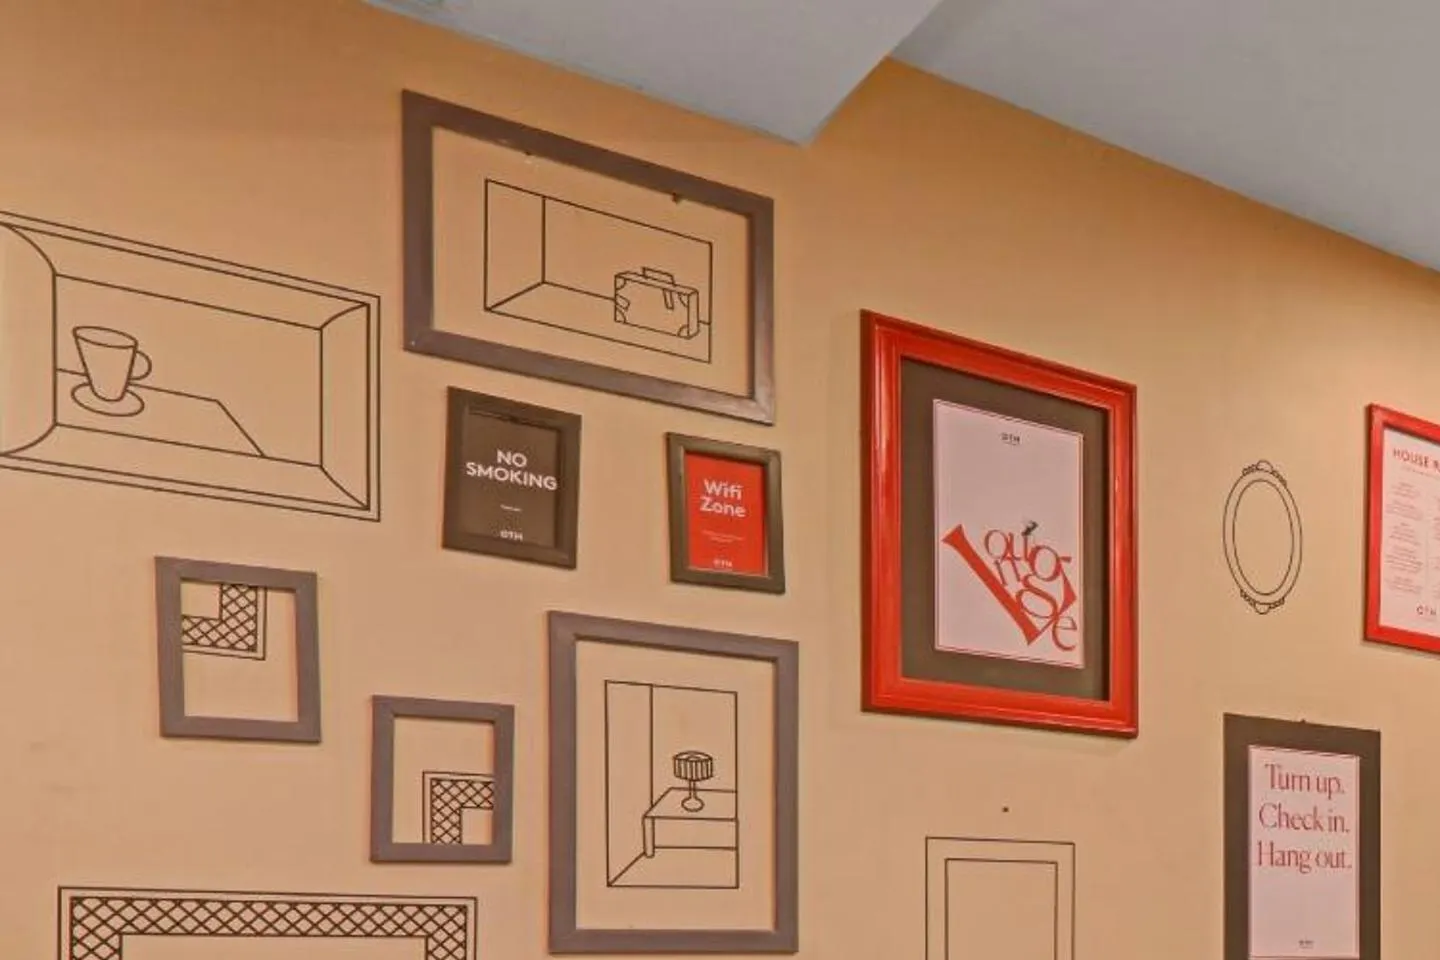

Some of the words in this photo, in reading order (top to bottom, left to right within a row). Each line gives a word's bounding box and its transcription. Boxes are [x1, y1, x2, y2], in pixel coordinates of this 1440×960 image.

[496, 449, 527, 468] NO
[1393, 448, 1429, 468] HOUSE
[465, 462, 558, 491] SMOKING
[703, 478, 743, 500] Wifi
[700, 496, 747, 517] Zone
[1264, 763, 1311, 793] Turn
[1316, 775, 1345, 800] up.
[1259, 802, 1324, 833] Check
[1328, 808, 1350, 834] in.
[1257, 840, 1312, 874] Hang
[1315, 850, 1352, 869] out.
